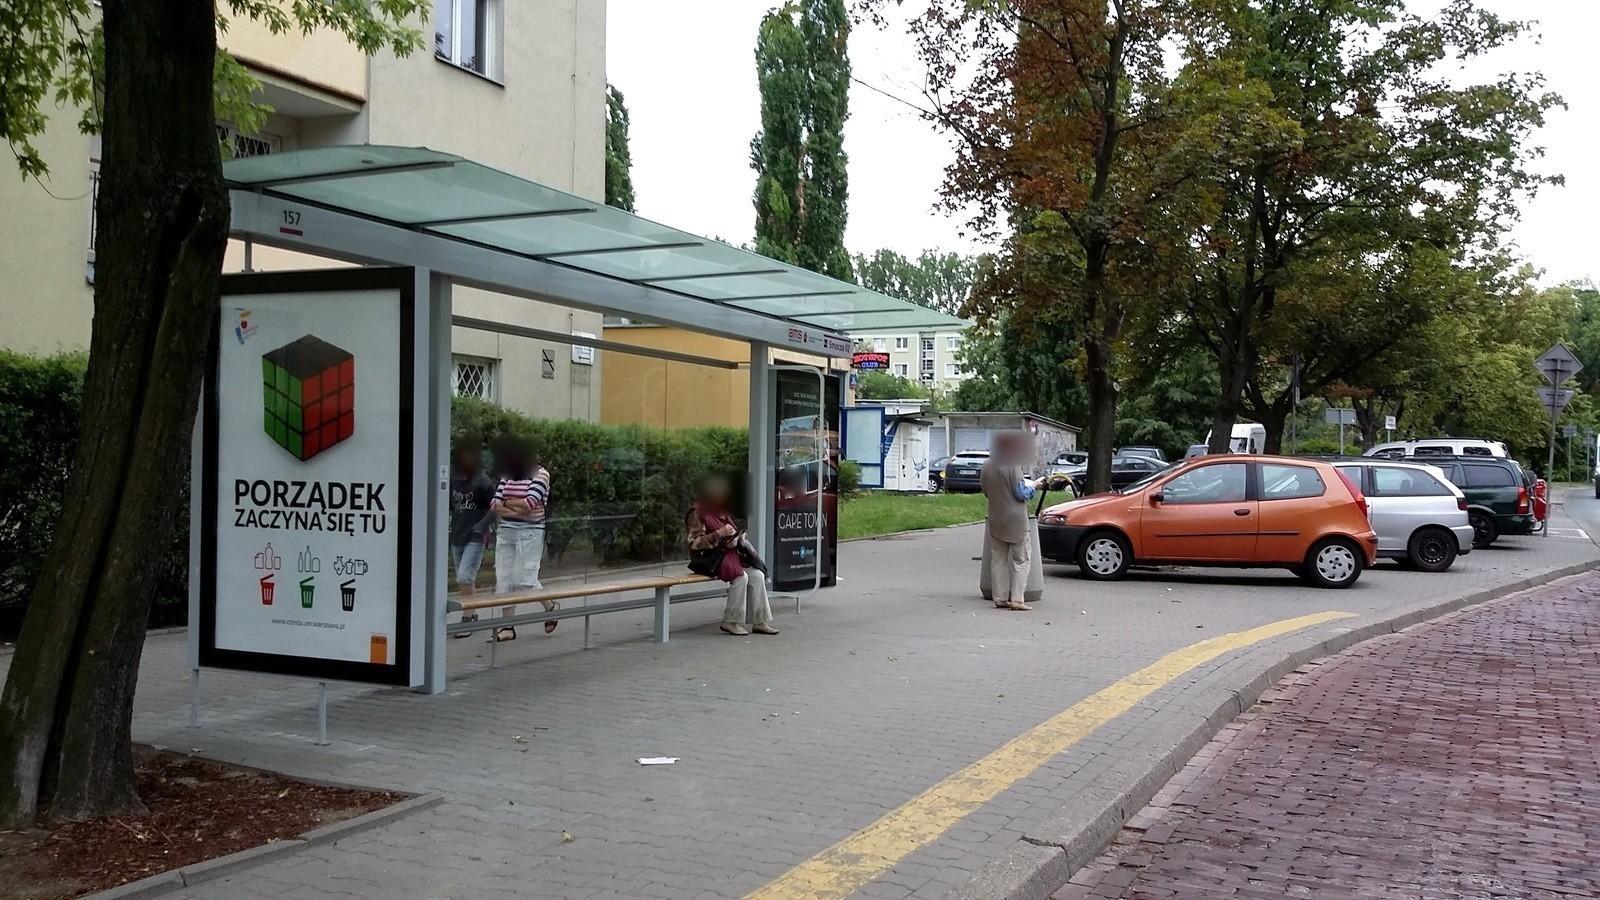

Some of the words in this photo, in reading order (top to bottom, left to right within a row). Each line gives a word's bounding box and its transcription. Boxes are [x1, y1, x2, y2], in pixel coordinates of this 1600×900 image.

[283, 209, 302, 226] 157
[235, 479, 386, 515] PORZĄDEK
[234, 508, 323, 531] ZACZYNA
[326, 512, 355, 537] SIĘ
[360, 513, 386, 534] TU
[778, 512, 802, 529] CAPE
